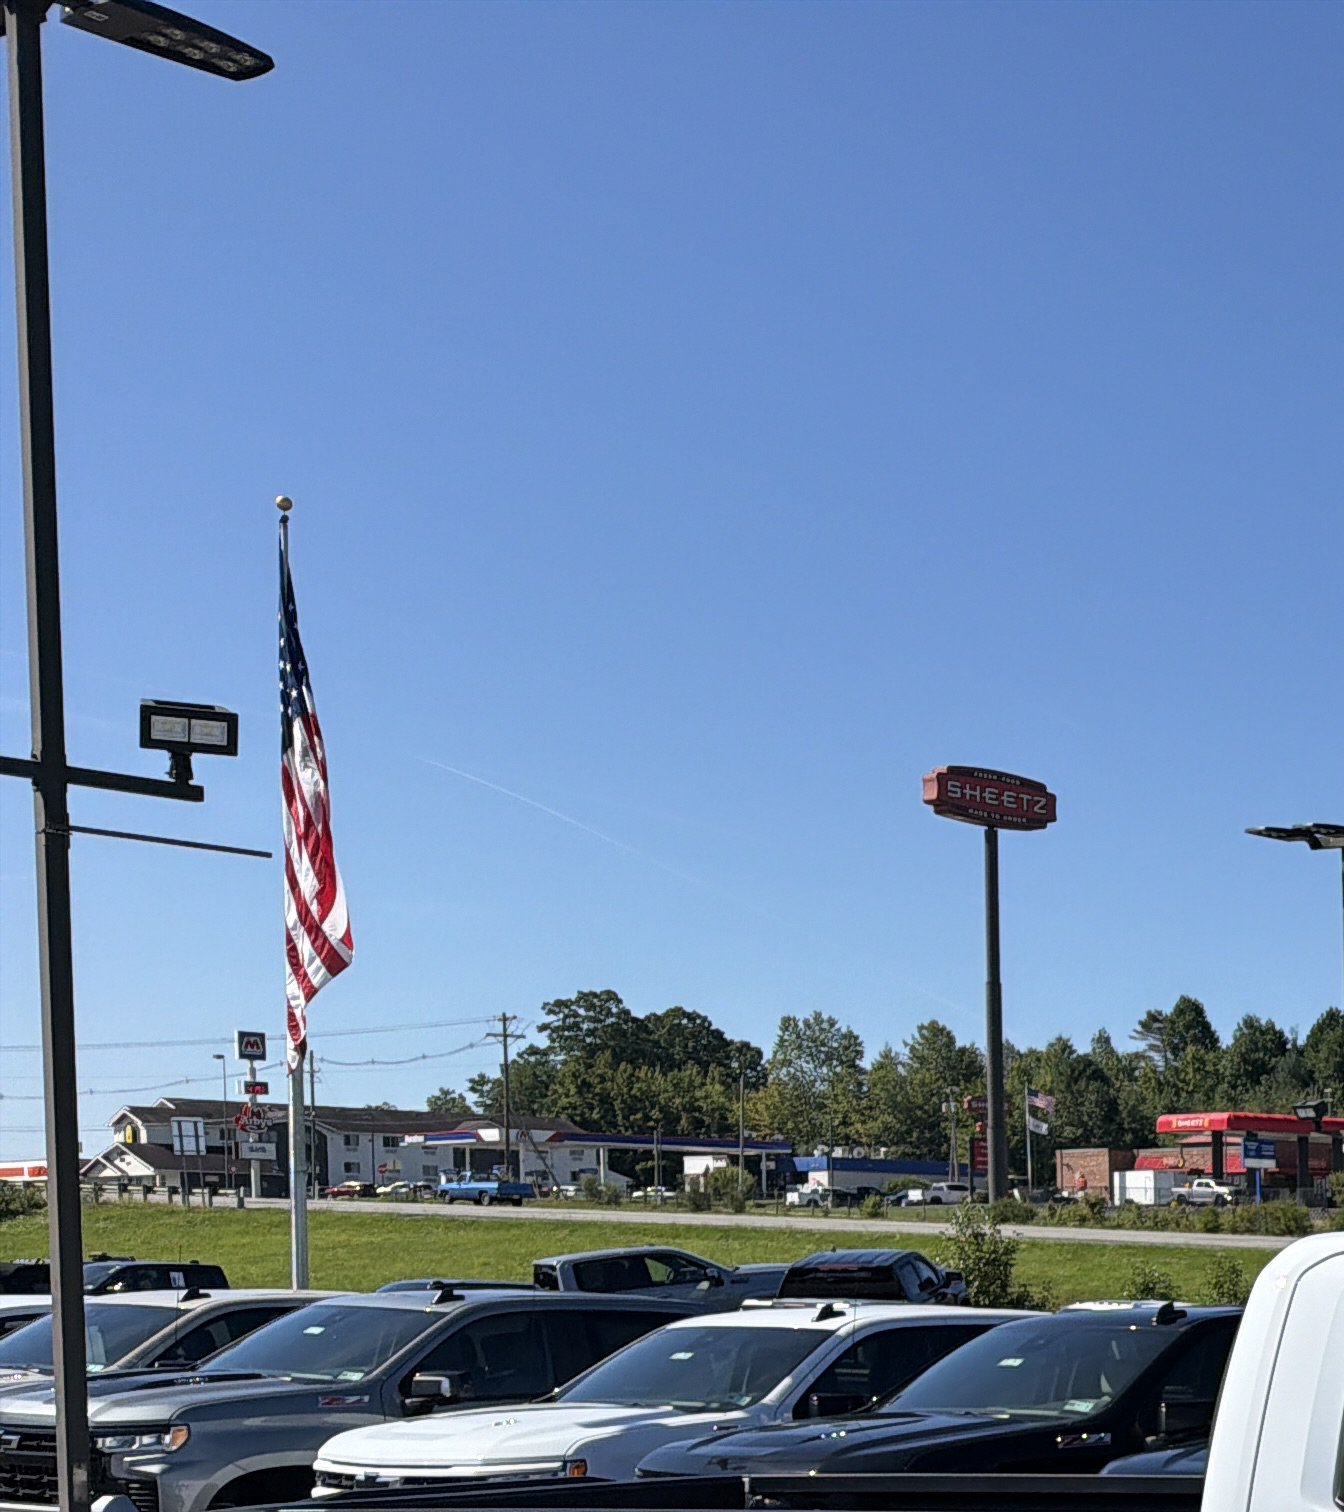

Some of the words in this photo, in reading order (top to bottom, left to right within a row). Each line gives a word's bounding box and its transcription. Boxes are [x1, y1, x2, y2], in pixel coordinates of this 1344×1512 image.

[1001, 776, 1021, 785] FOOD
[947, 780, 1047, 814] SHEETZ
[968, 808, 988, 818] MADE
[1003, 815, 1027, 824] ORDER
